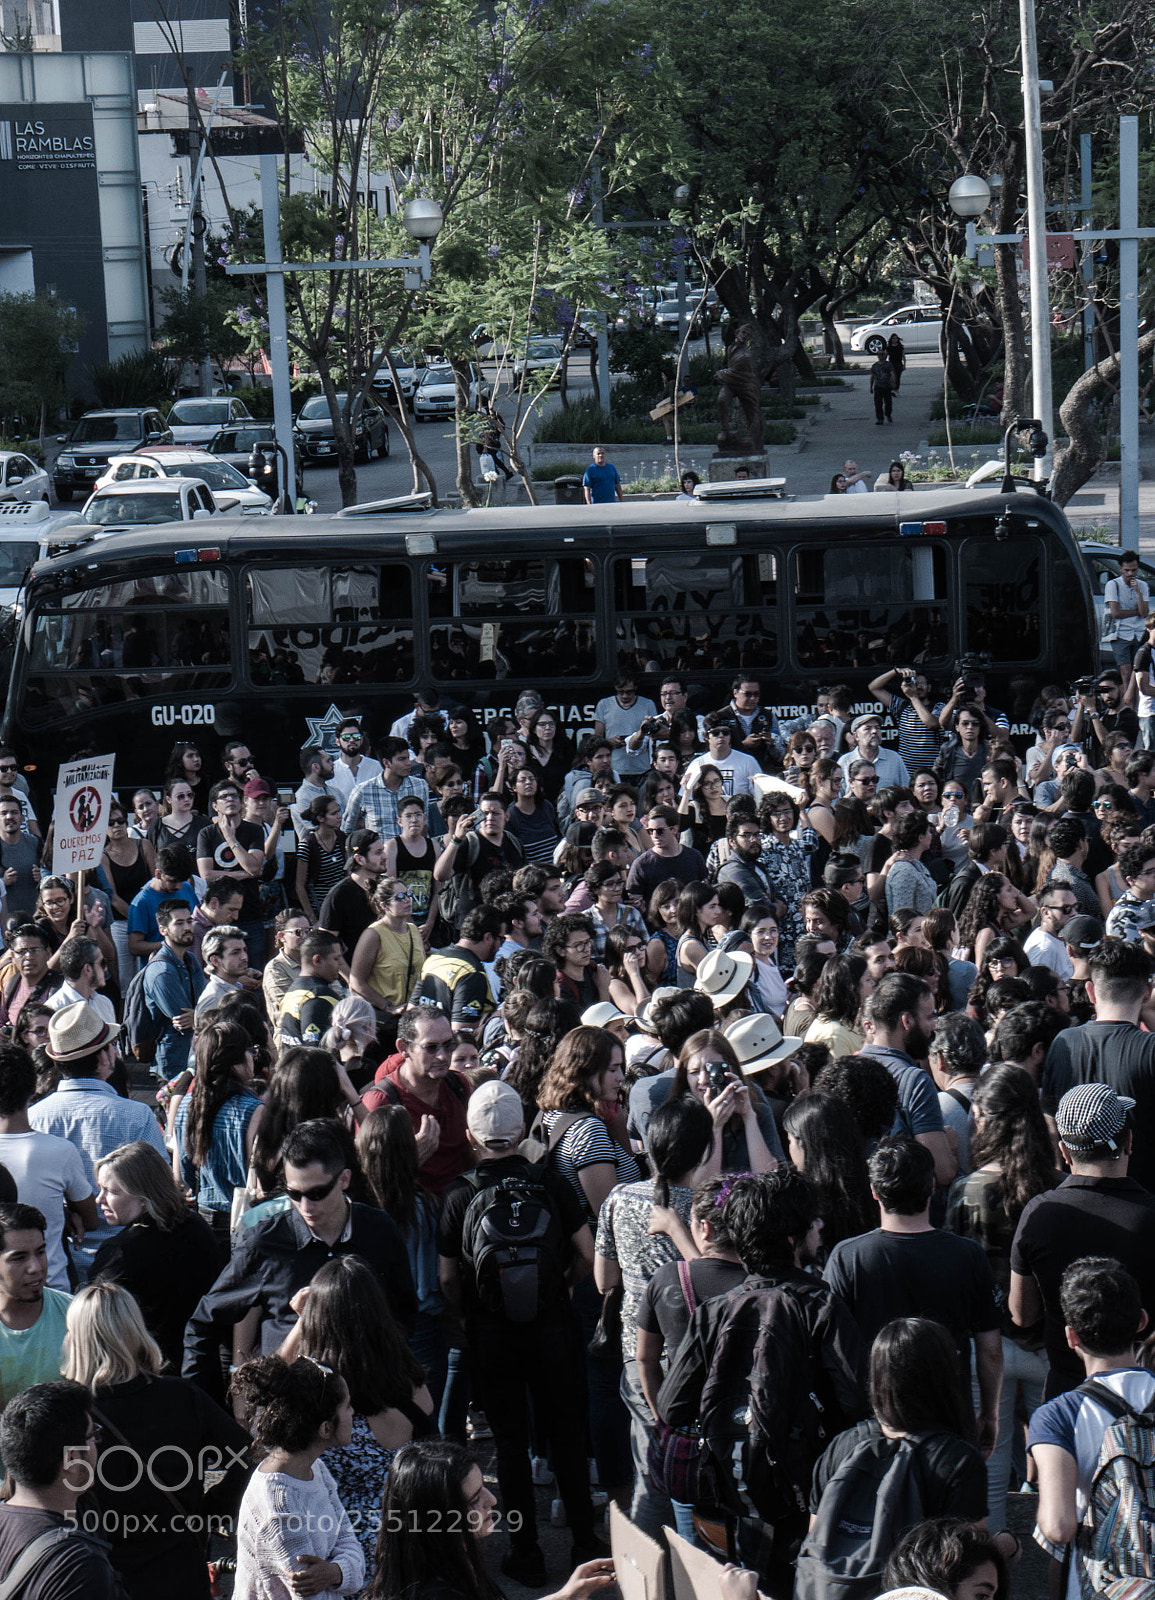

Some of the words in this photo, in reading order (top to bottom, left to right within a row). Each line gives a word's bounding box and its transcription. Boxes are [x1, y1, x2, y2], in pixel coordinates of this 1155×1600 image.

[15, 121, 45, 135] LAS
[16, 136, 93, 152] RAMBLAS
[151, 704, 215, 726] GU-020
[60, 833, 102, 850] QUEREMOS
[72, 848, 95, 864] PAZ
